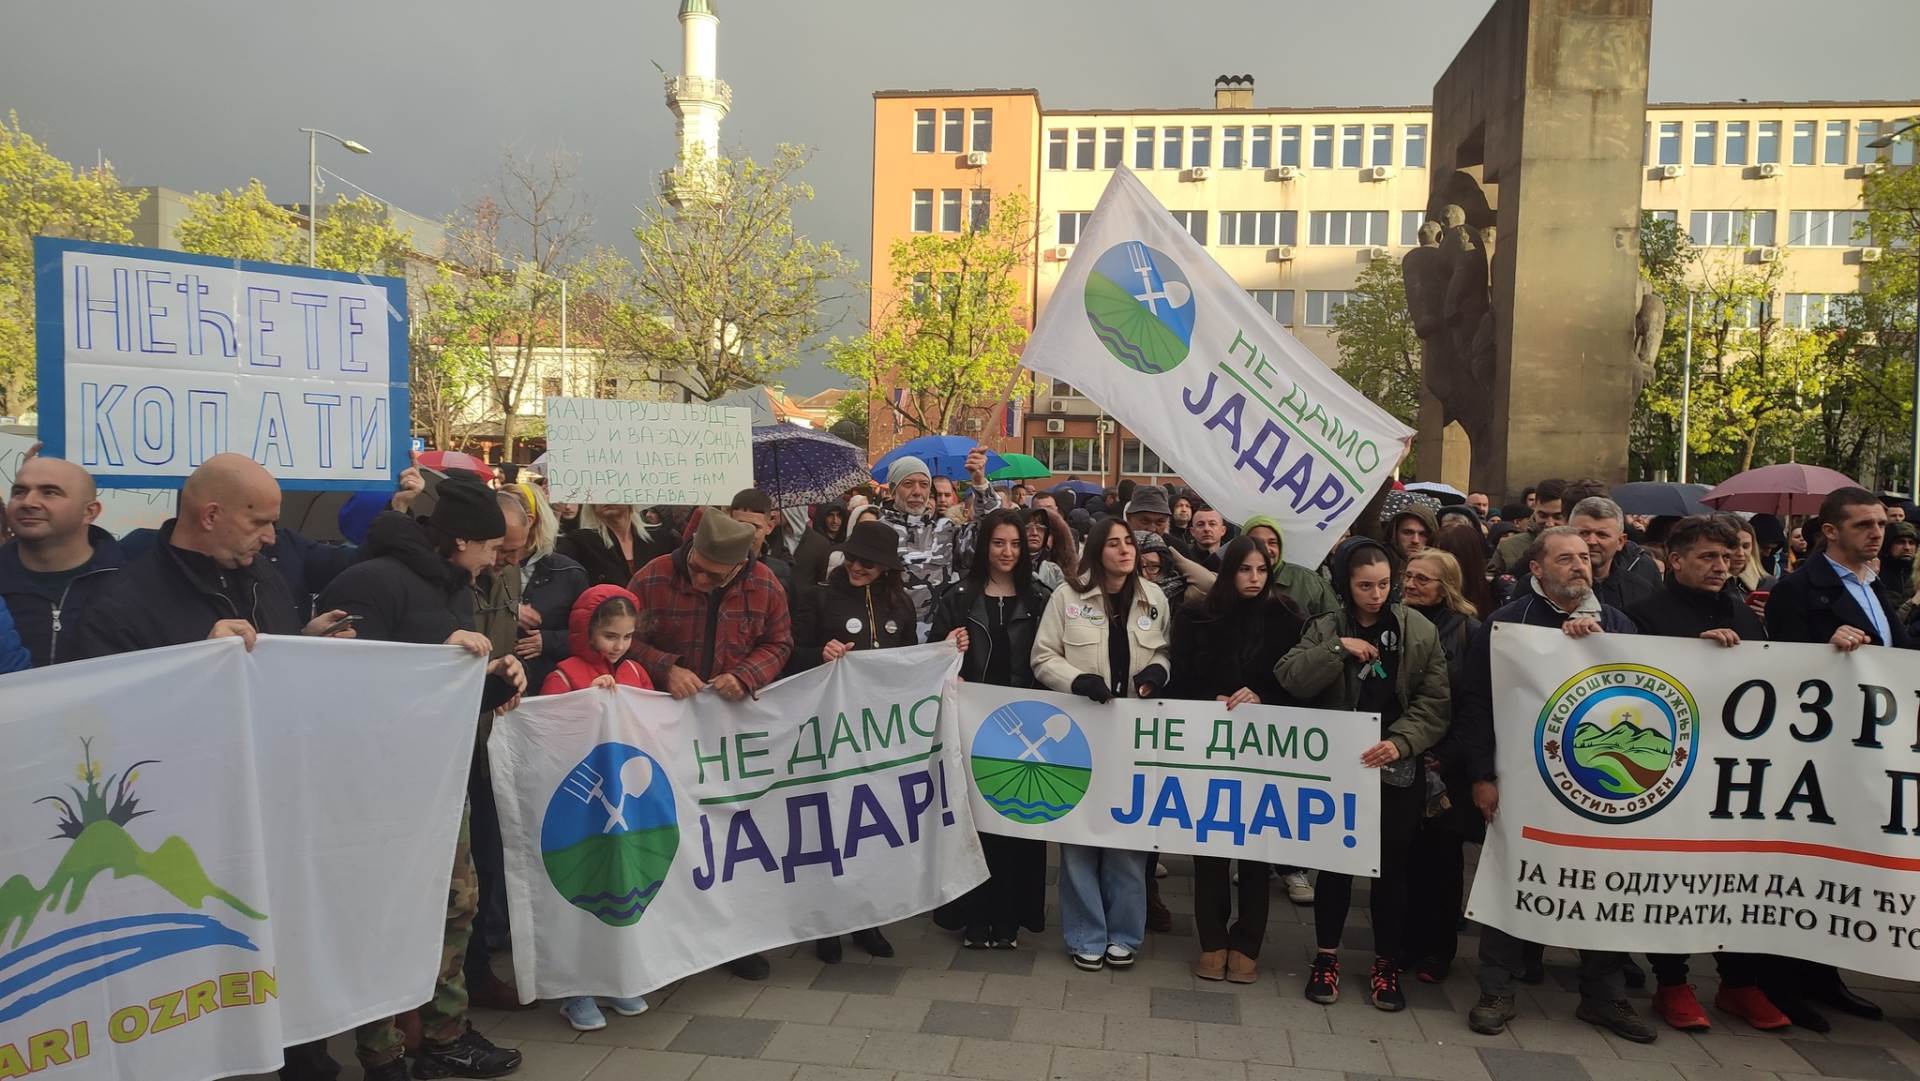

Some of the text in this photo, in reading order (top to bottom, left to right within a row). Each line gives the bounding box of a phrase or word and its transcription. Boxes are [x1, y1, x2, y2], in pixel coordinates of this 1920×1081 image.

[75, 265, 369, 372] НЕЋЕТЕ
[81, 383, 387, 469] КОПАТИ
[547, 424, 597, 442] ВОДУ
[608, 428, 622, 442] И
[548, 399, 600, 425] КАД
[1228, 328, 1380, 473] НЕ ДАМО
[549, 469, 726, 488] ДОЛАРИ КОЈЕ НАМ
[587, 448, 624, 465] НАМ
[695, 453, 740, 467] БИТИ
[1182, 371, 1355, 531] ЈАДАР!
[693, 695, 943, 785] НЕ ДАМО
[1133, 717, 1330, 762] НЕ ДАМО
[1548, 673, 1690, 742] ЕКОЛОШКО УДРУЖЕЊЕ
[692, 759, 956, 891] ЈАДАР!
[1110, 773, 1357, 849] ЈАДАР!
[1553, 771, 1675, 814] ГОСТИЉ-ОЗРЕН
[1709, 757, 1837, 825] НА
[1515, 890, 1586, 923] КОЈА
[1596, 903, 1635, 924] МЕ
[1644, 903, 1733, 927] ПРАТИ,
[1741, 903, 1818, 931] НЕГО
[1828, 913, 1877, 942] ПО
[1517, 859, 1917, 916] ЈА НЕ ОДЛУЧУЈЕМ ДА ЛИ ЋУ
[108, 966, 280, 1044] OZREN
